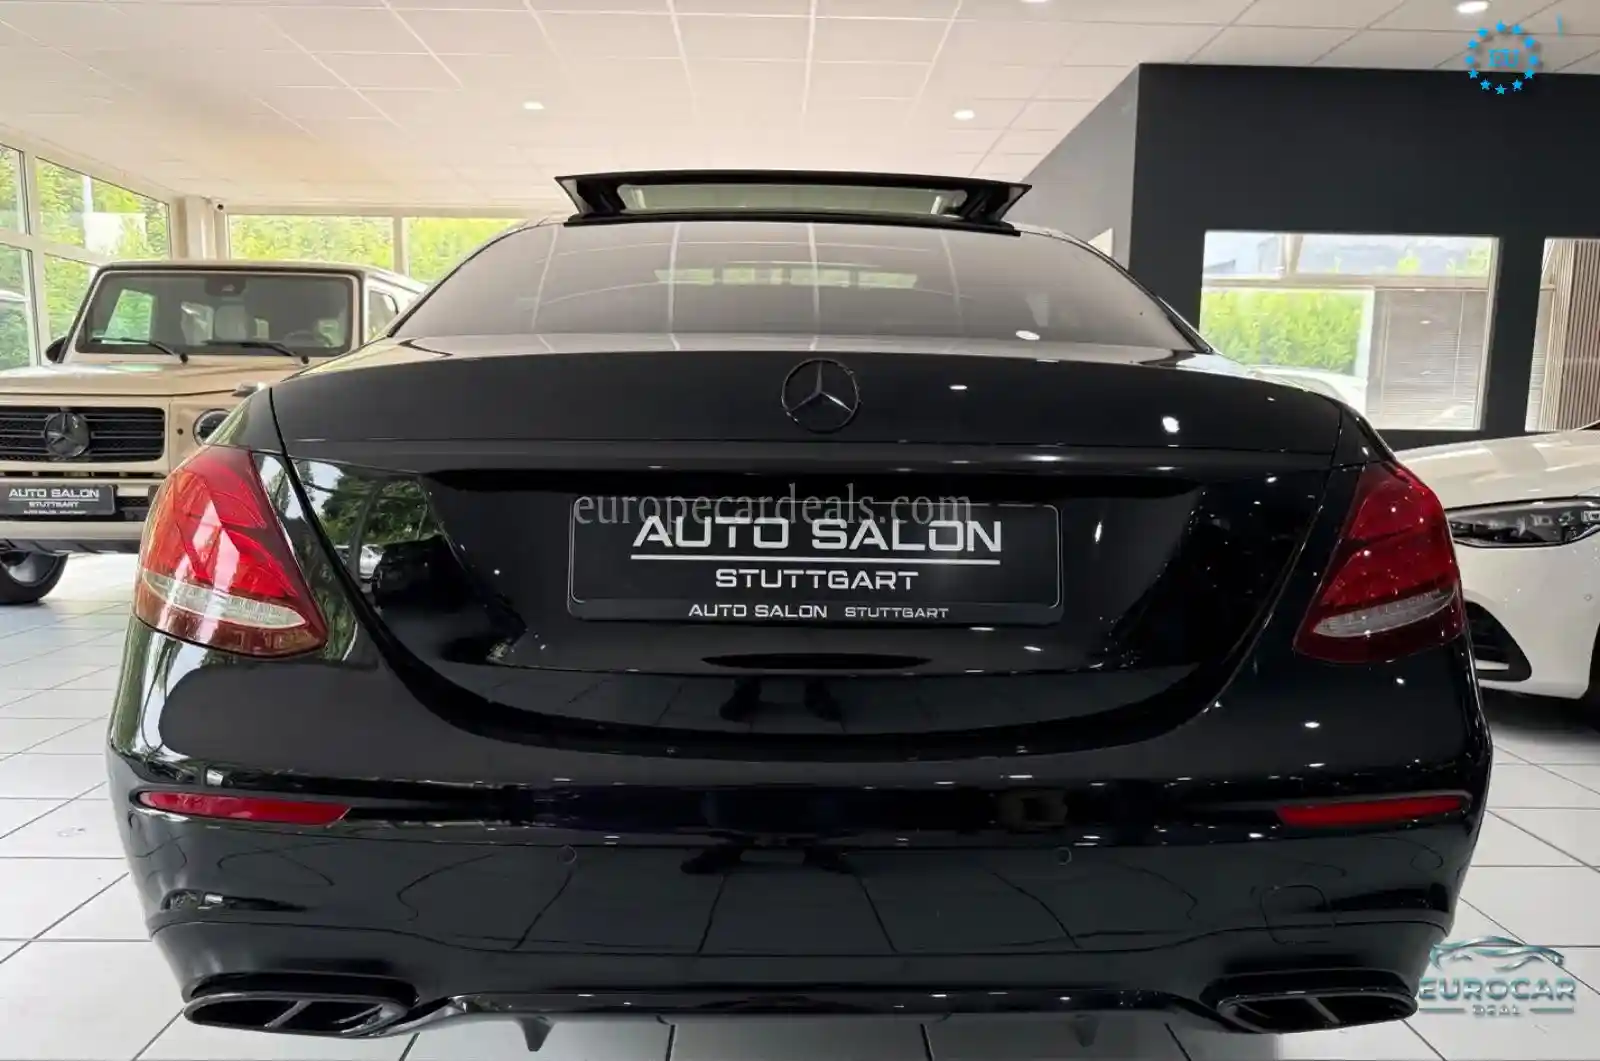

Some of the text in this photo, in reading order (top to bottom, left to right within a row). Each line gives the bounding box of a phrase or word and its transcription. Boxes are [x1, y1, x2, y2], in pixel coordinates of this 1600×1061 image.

[9, 488, 99, 498] AUTO SALON
[632, 515, 1002, 552] AUTO SALON
[715, 568, 919, 592] STUTTGART
[688, 604, 949, 620] AUTO SALON STUTTGART
